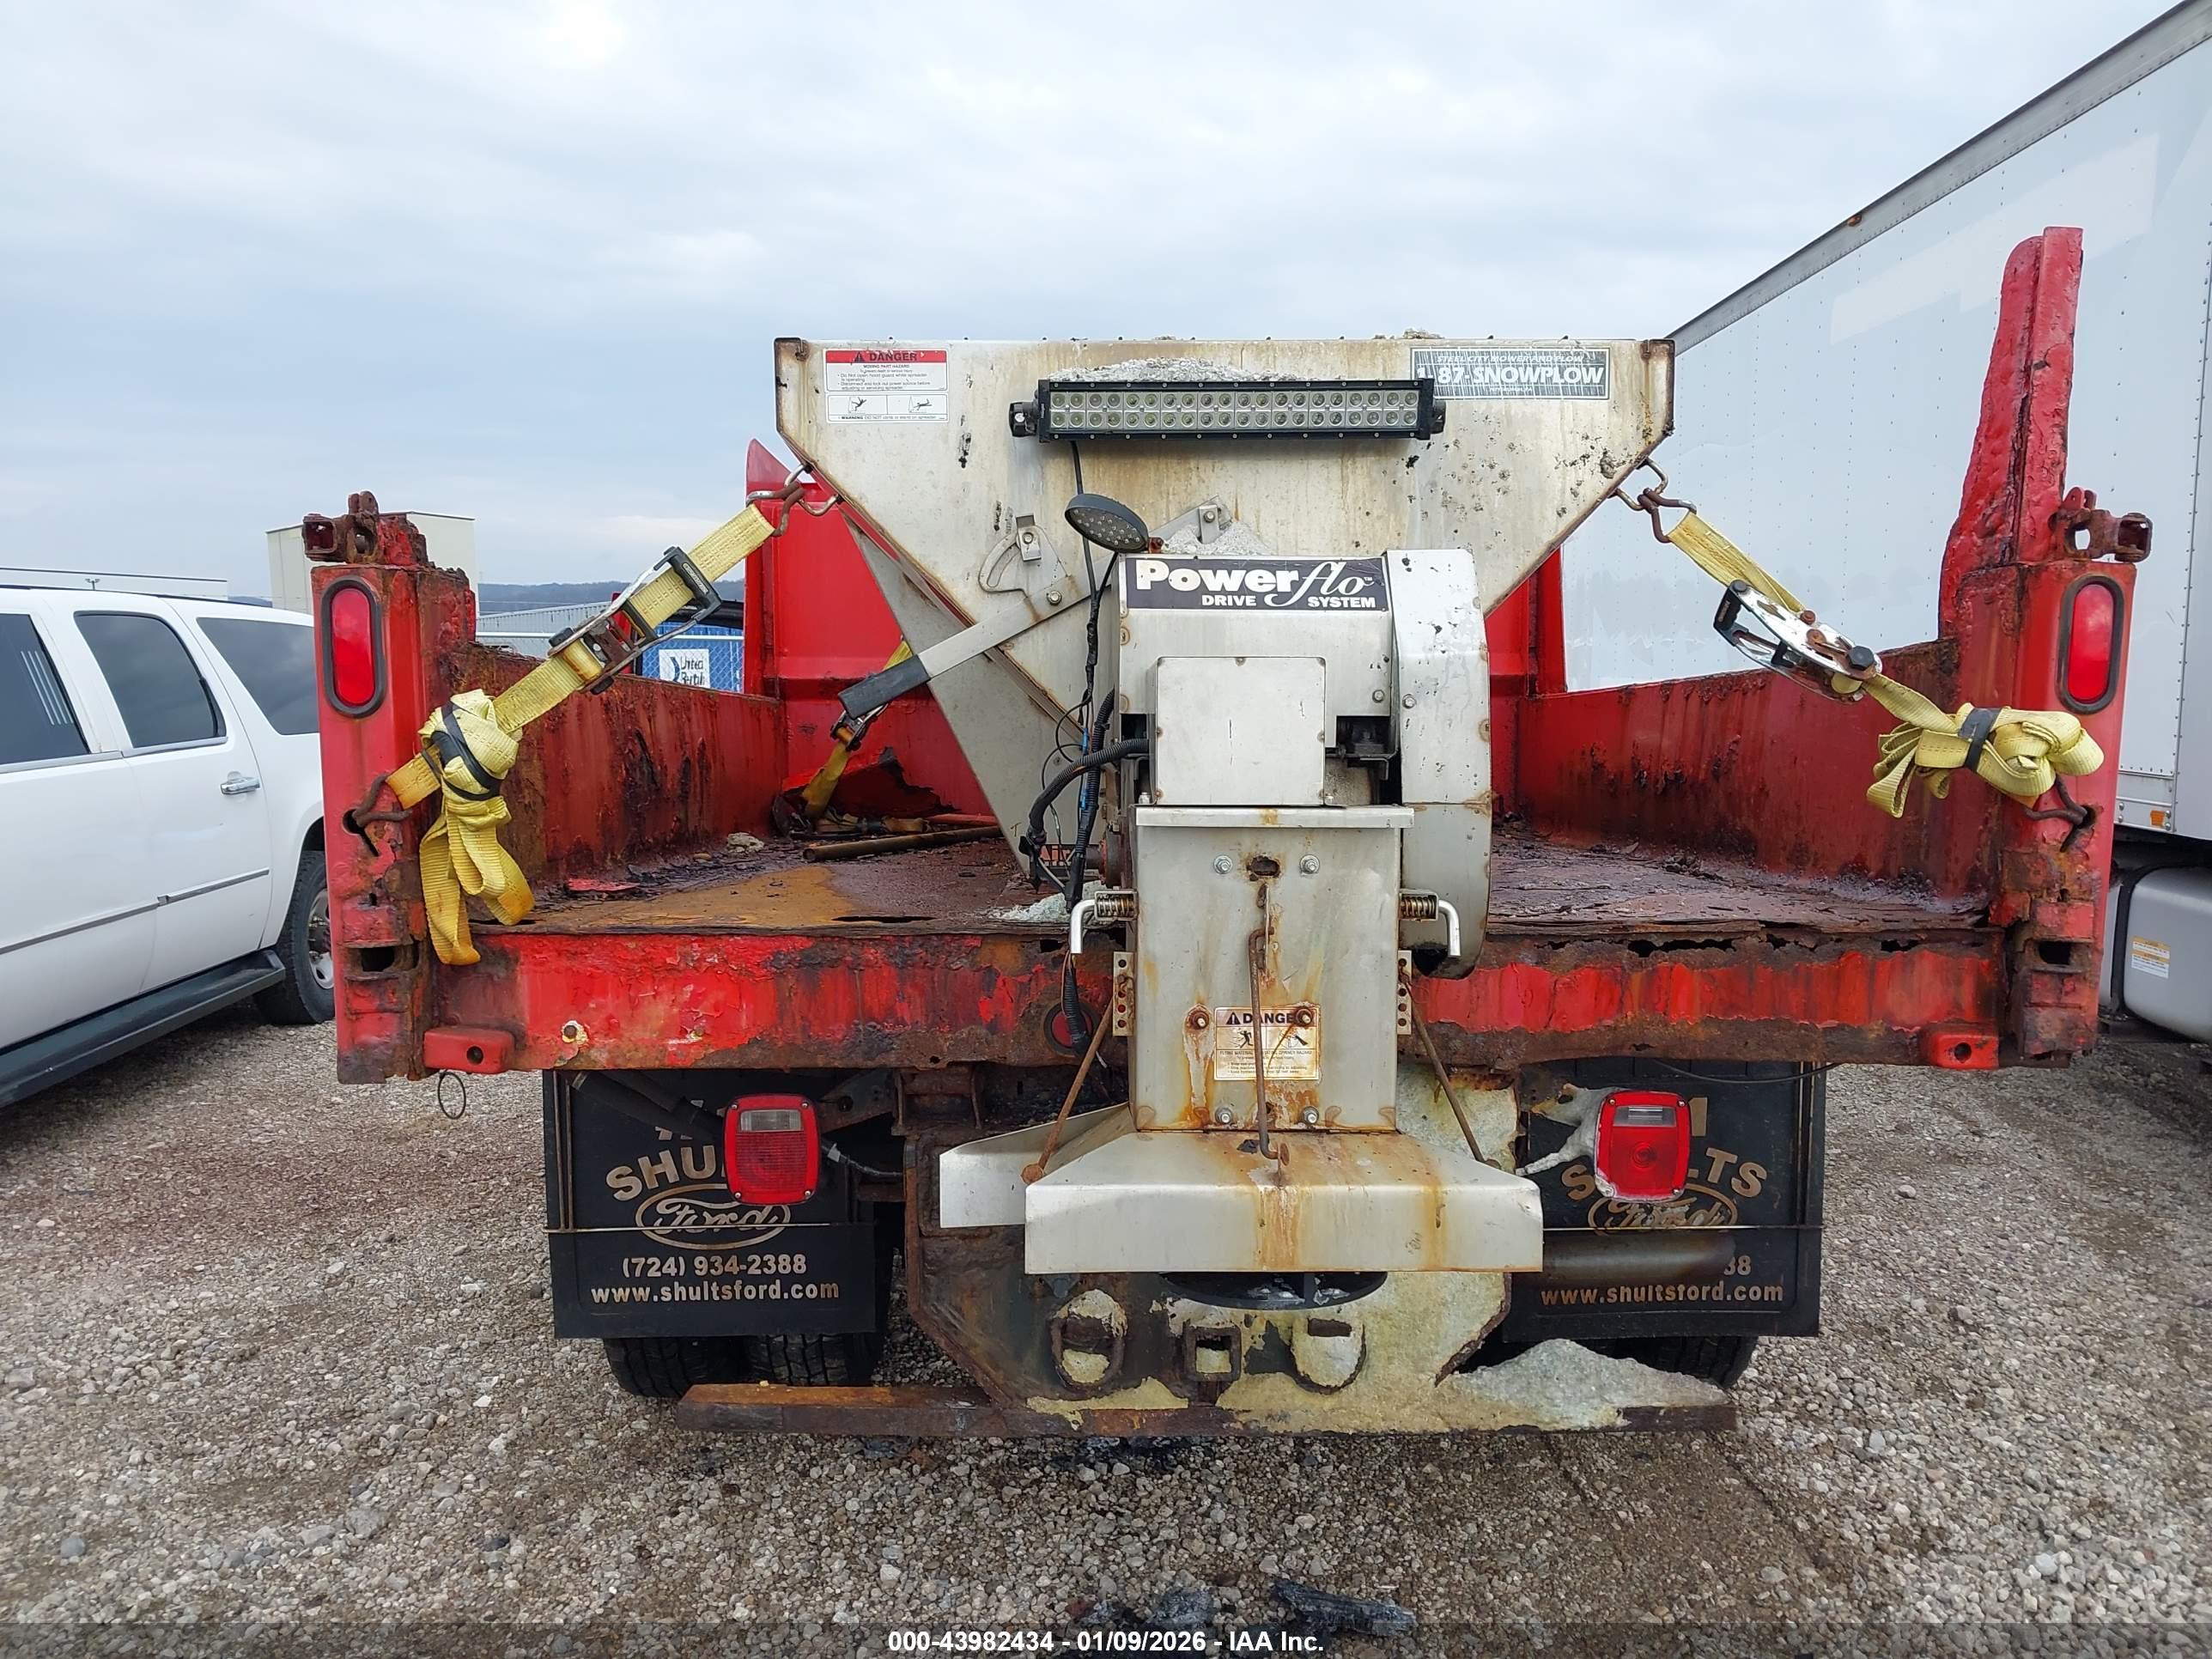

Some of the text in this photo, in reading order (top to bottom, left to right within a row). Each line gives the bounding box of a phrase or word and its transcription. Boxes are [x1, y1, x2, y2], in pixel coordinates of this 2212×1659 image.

[869, 352, 918, 362] DANGER
[1202, 594, 1376, 608] DRIVE SYSTEM
[605, 1145, 726, 1201] SHU
[1561, 1146, 1768, 1201] STS
[653, 1197, 779, 1235] Ford
[623, 1254, 807, 1278] (724) 934-2388
[591, 1279, 840, 1304] www.shultsford.com
